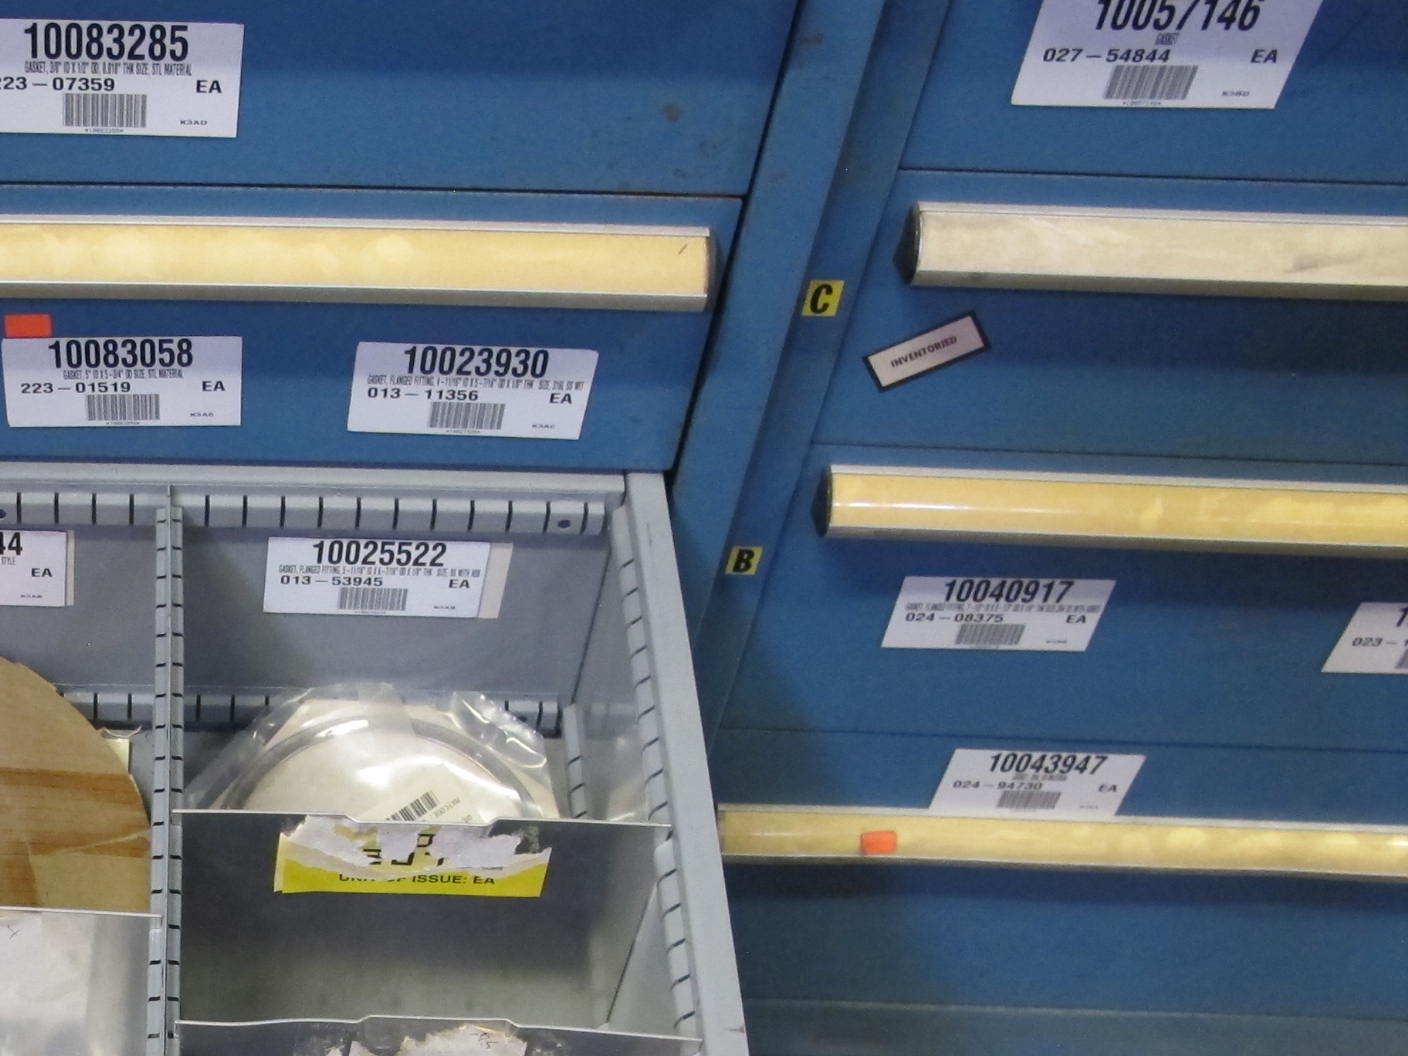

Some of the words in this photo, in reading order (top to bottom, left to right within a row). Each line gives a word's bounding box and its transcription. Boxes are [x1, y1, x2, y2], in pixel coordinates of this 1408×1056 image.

[24, 22, 189, 61] 10083285
[1251, 49, 1278, 64] EA
[196, 79, 222, 94] EA
[810, 284, 833, 314] C
[48, 338, 194, 368] 10083058
[404, 346, 549, 378] 10023930
[891, 336, 957, 368] INVENTORIED
[202, 381, 225, 392] EA
[549, 393, 573, 404] EA
[313, 540, 447, 567] 10025522
[733, 550, 754, 572] B
[31, 568, 53, 578] EA
[449, 579, 470, 589] EA
[944, 579, 1074, 604] 10040917
[1066, 615, 1087, 624] EA
[990, 753, 1109, 775] 10043947
[1098, 784, 1117, 792] EA
